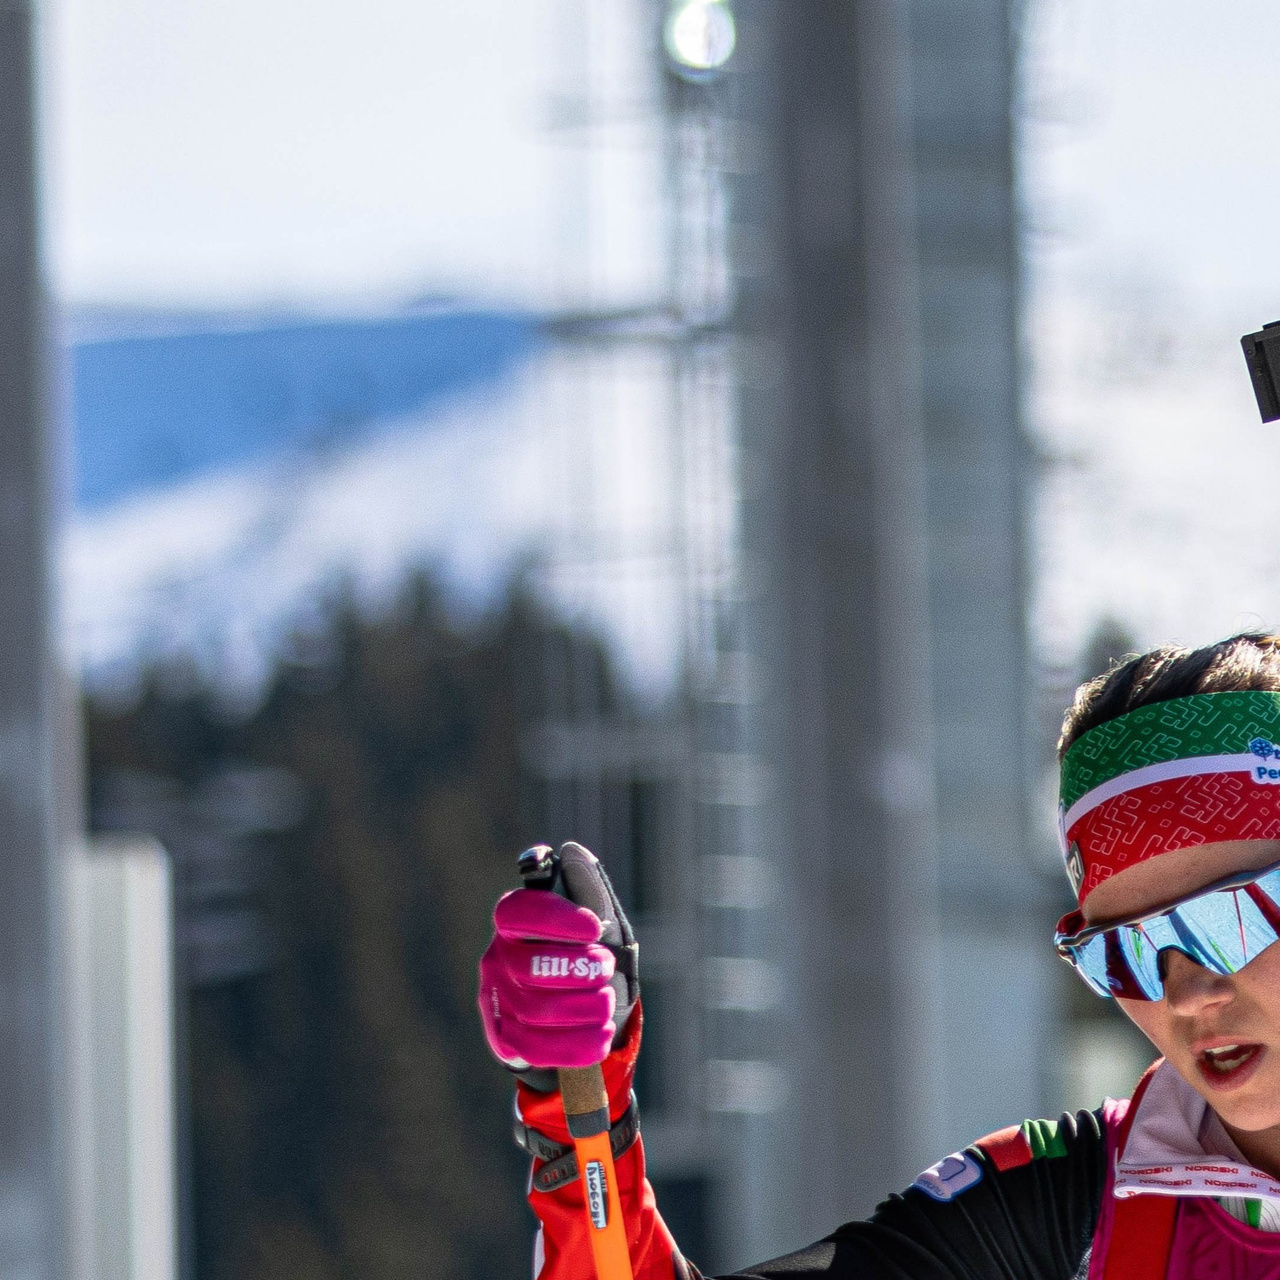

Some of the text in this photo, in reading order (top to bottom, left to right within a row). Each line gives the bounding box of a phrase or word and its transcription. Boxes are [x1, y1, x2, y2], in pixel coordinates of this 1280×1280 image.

[1120, 1166, 1173, 1175] NORDSKI
[1185, 1165, 1239, 1174] NORDSKI
[1139, 1178, 1193, 1187] NORDSKI
[1204, 1179, 1258, 1189] NORDSKI
